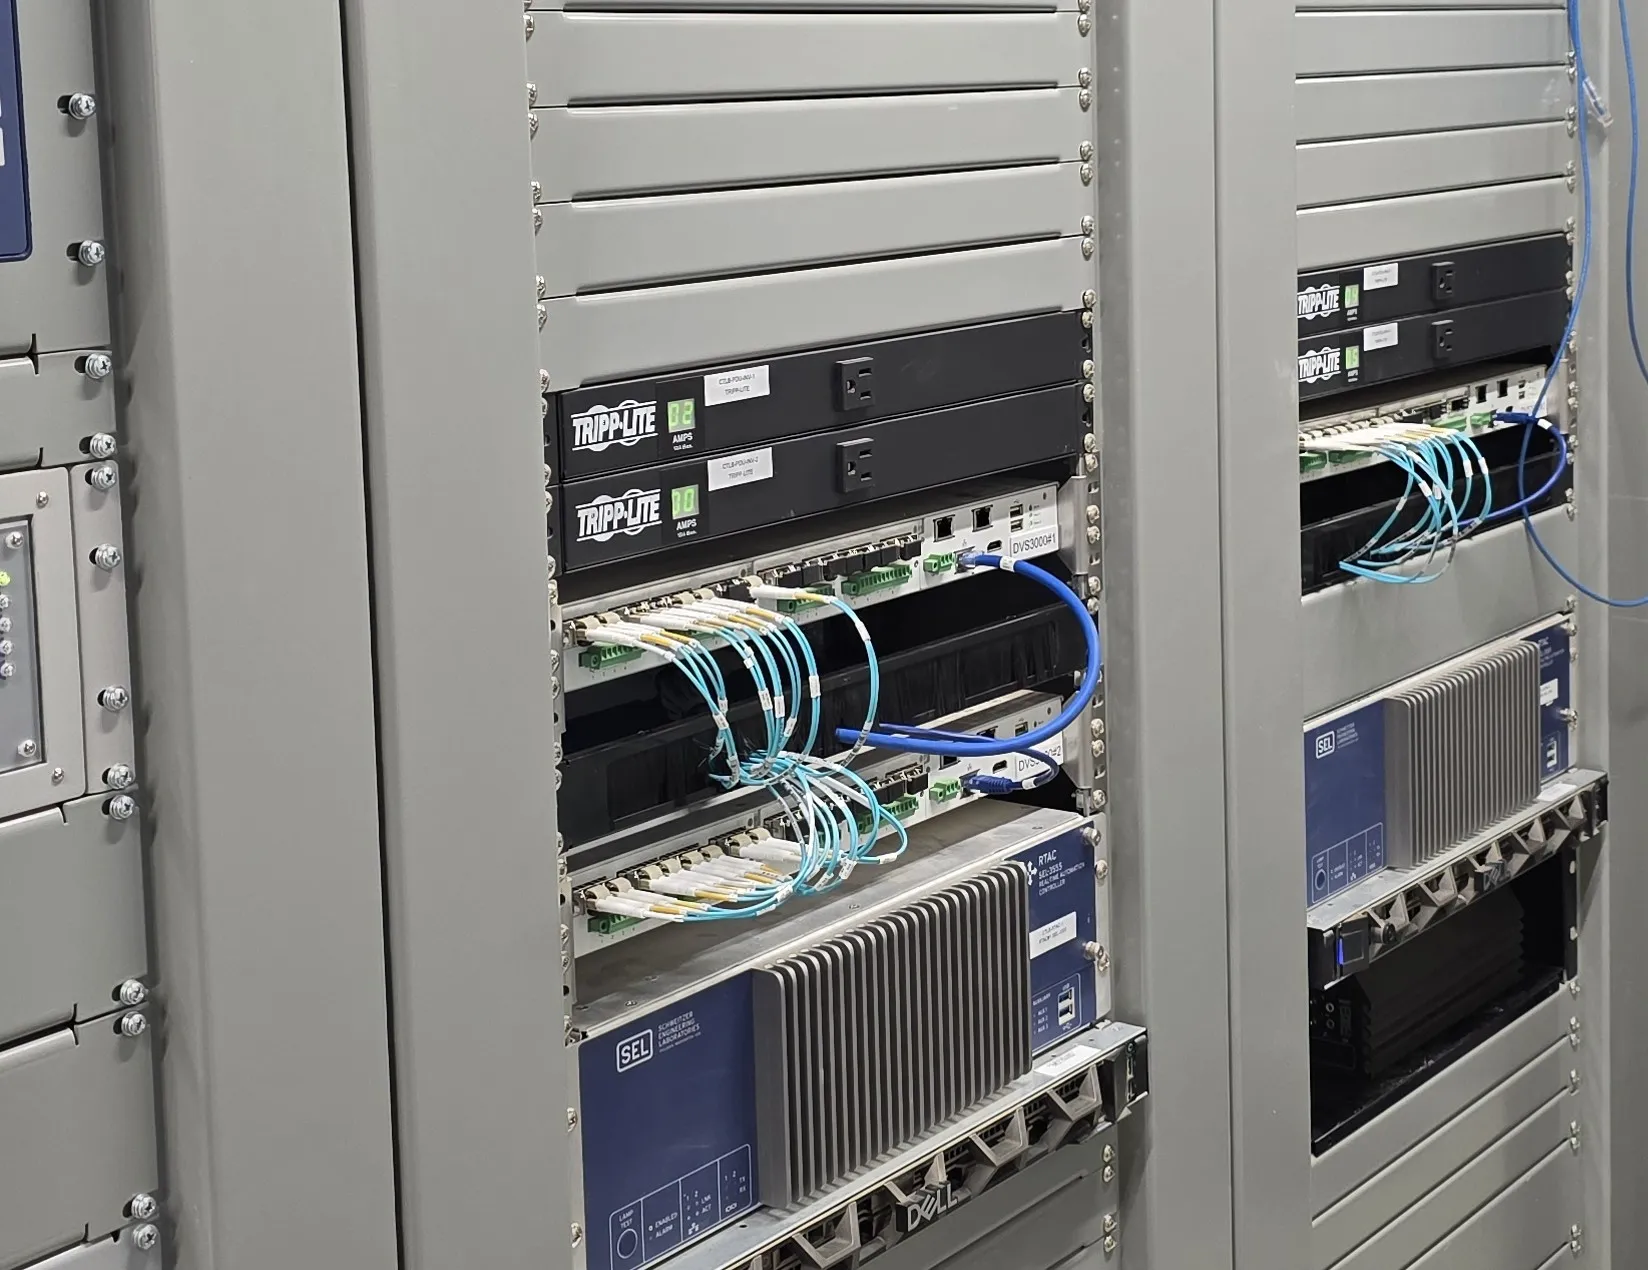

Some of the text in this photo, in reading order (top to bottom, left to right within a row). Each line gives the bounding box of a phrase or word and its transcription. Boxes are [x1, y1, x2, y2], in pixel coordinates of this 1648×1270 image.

[672, 432, 693, 443] AMPS
[676, 519, 697, 531] AMPS
[1013, 533, 1056, 554] DVS3000#1
[1318, 737, 1333, 754] SEL
[1038, 849, 1057, 867] RTAC
[658, 1023, 701, 1048] LABORATORIES
[621, 1038, 649, 1065] SEL
[618, 1209, 634, 1222] LAMP
[701, 1203, 712, 1214] ACT
[907, 1183, 958, 1232] DELL
[620, 1218, 633, 1229] TEST
[655, 1211, 678, 1228] ENABLED
[655, 1224, 674, 1238] ALARM
